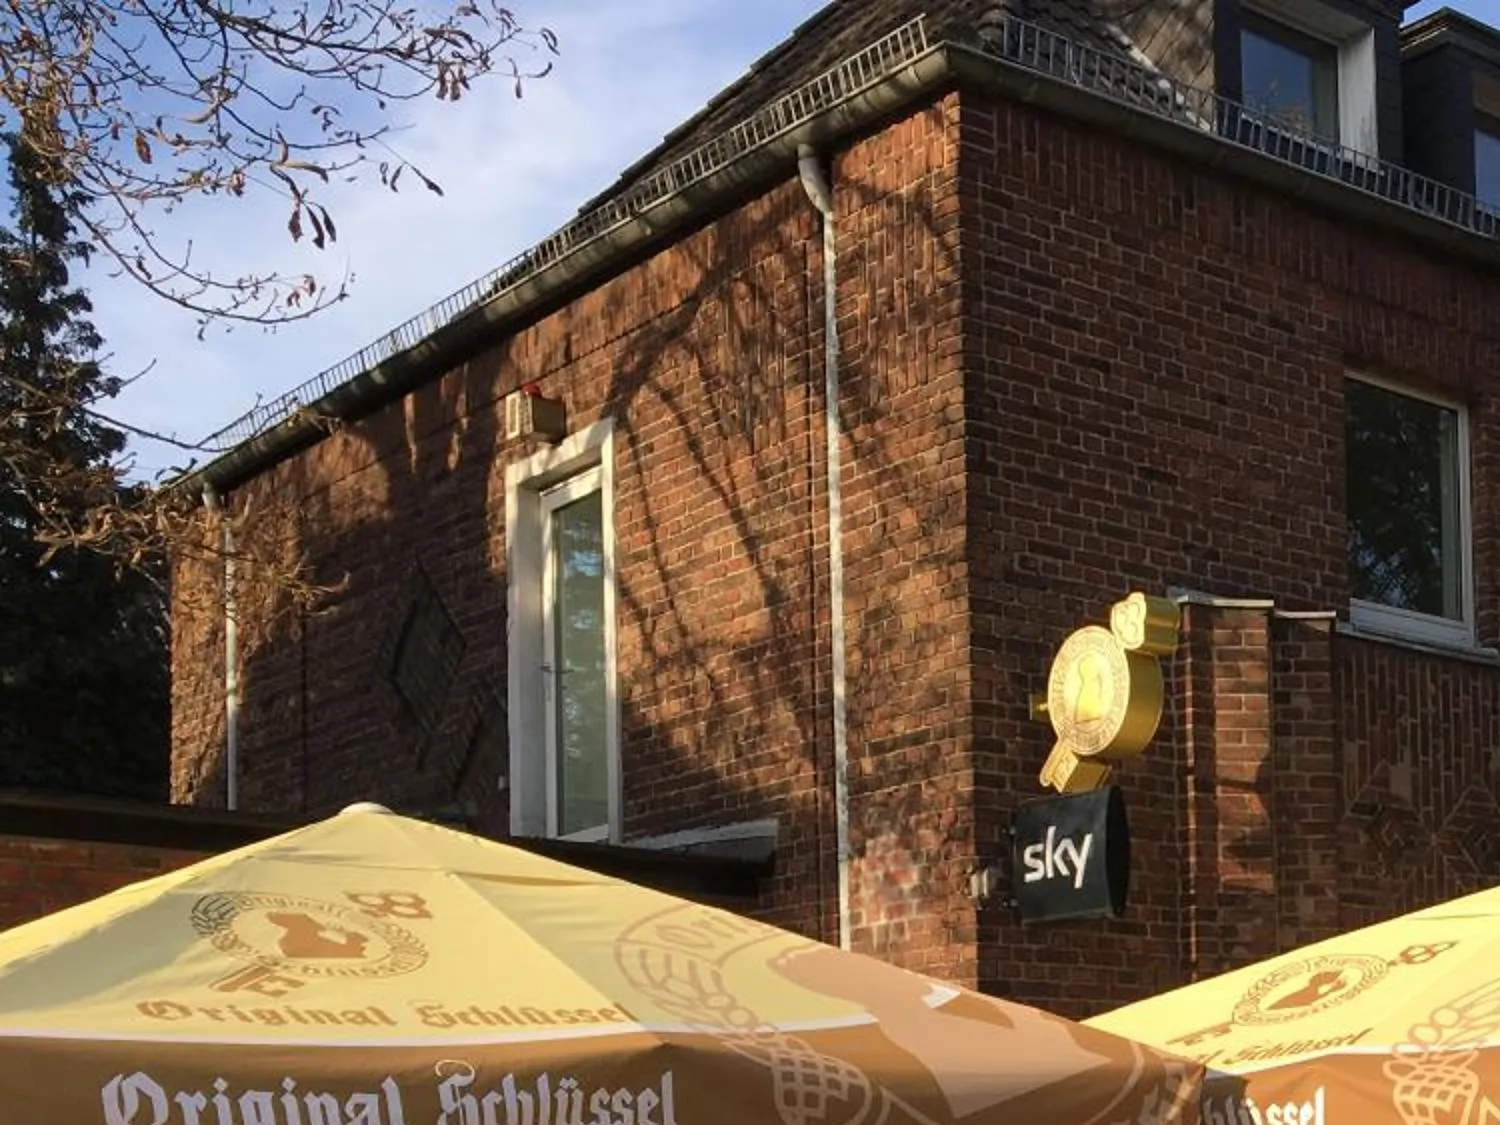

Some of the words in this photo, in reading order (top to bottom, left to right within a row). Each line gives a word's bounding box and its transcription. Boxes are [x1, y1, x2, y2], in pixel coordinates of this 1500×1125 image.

[1023, 825, 1094, 890] sky
[134, 998, 399, 1027] Original
[415, 1000, 640, 1030] Schlüssel
